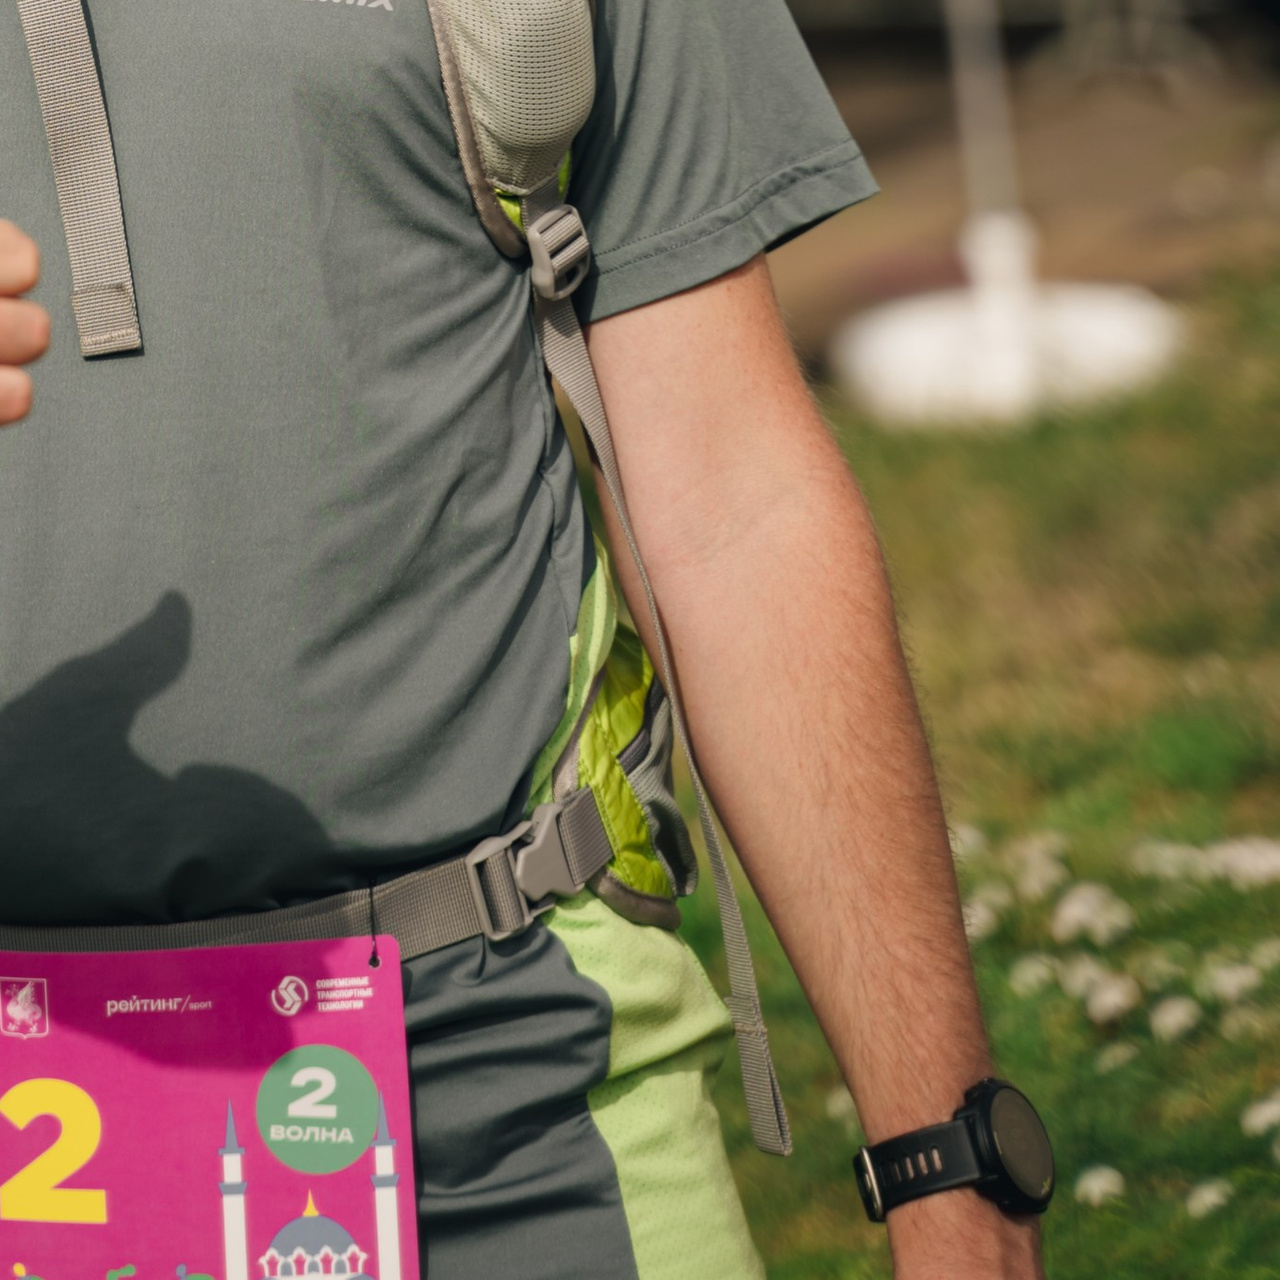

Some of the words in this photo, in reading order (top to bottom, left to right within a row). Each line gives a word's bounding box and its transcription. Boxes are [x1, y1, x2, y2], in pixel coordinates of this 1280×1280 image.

[316, 976, 369, 988] СОВРЕМЕННЫЕ
[317, 987, 373, 1000] ТРАНСПОРТНЫЕ
[318, 999, 364, 1012] ТЕХНОЛОГИИ
[286, 1066, 338, 1120] 2
[269, 1123, 354, 1144] ВОЛНА
